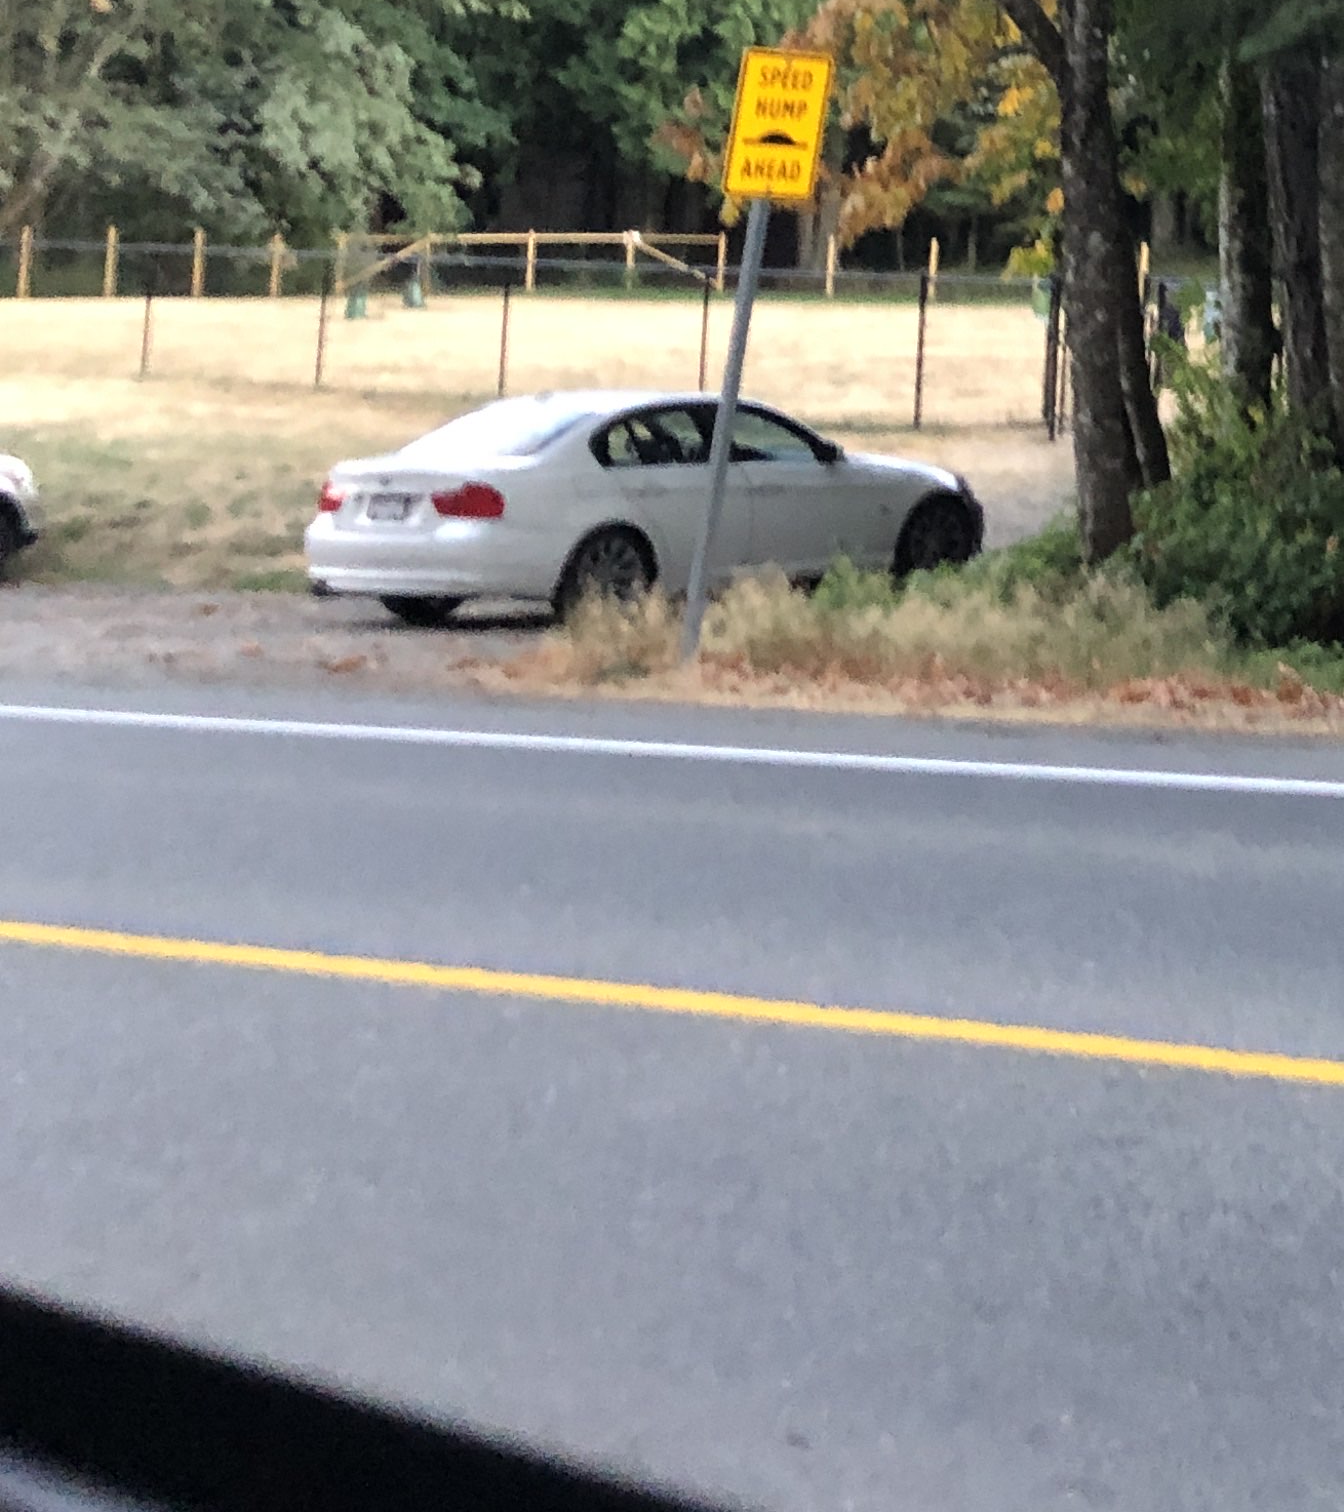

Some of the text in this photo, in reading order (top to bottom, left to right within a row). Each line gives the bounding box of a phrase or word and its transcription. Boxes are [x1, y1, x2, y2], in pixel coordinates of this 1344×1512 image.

[759, 65, 813, 91] SPEED
[755, 96, 808, 121] HUMP
[741, 158, 801, 182] AHEAD
